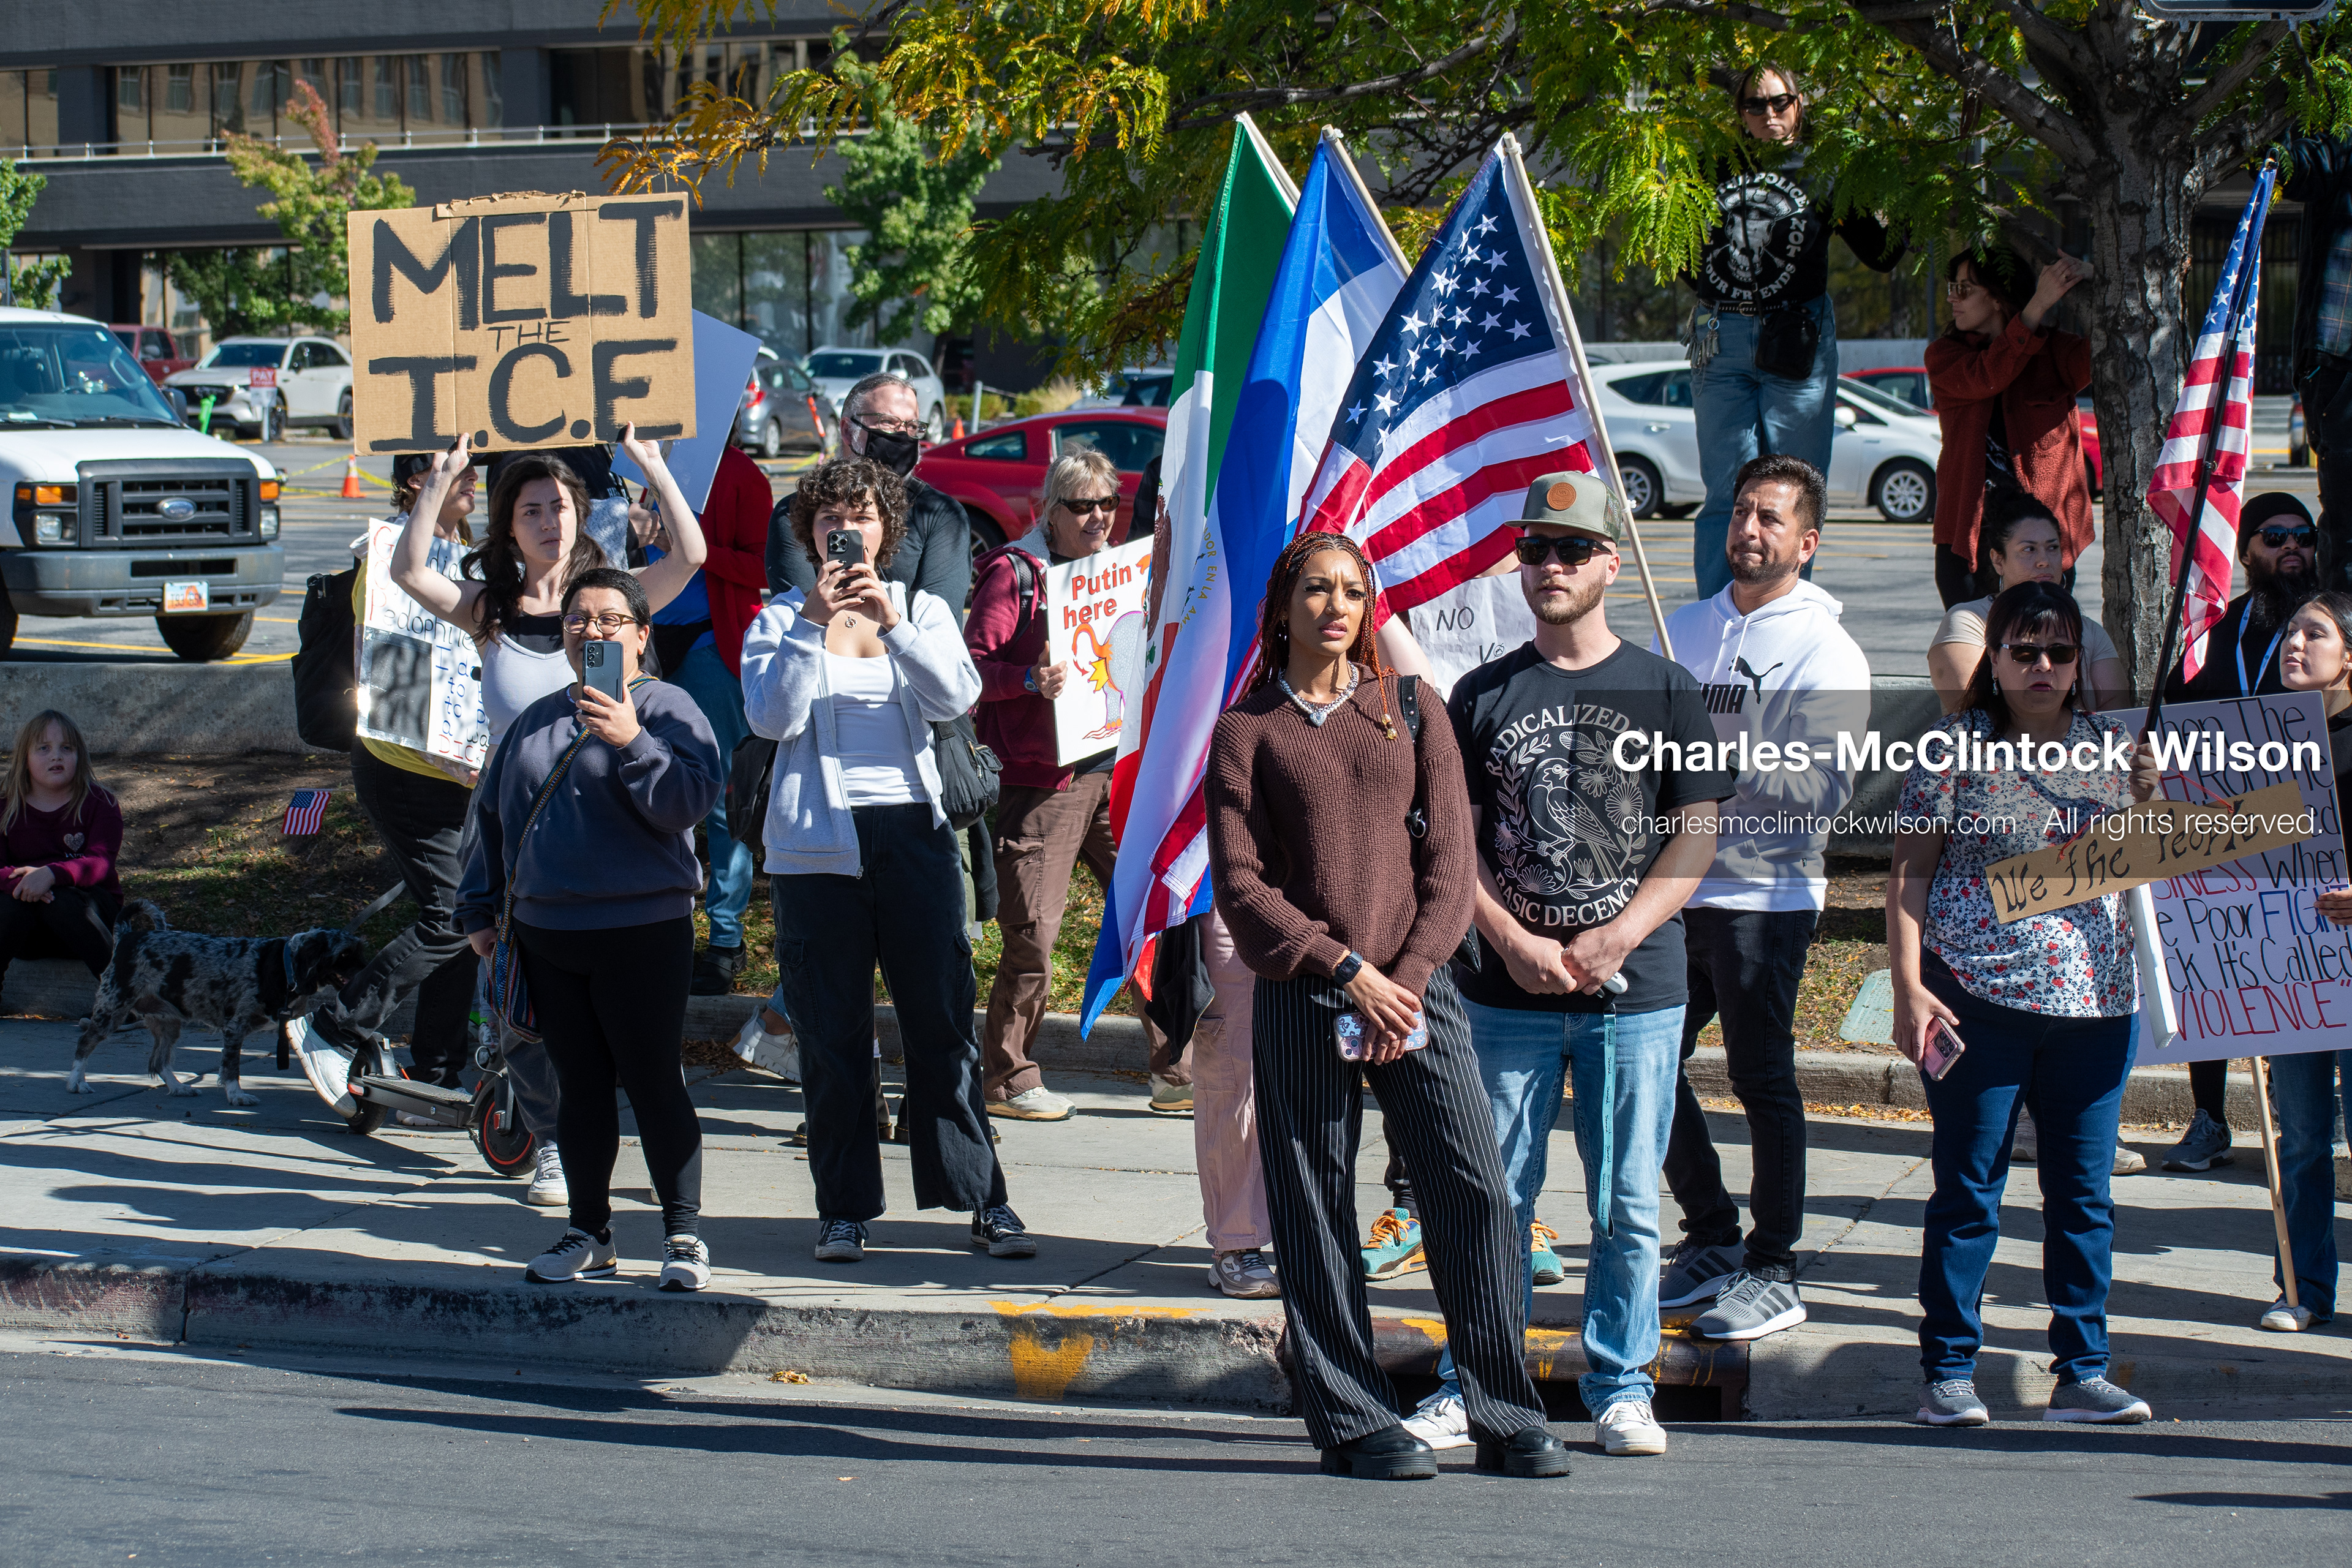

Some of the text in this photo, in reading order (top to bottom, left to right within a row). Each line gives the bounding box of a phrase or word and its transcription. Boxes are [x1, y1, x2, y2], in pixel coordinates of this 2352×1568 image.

[1753, 172, 1809, 208] POLICE
[1786, 217, 1807, 258] NOT
[372, 200, 684, 331] MELT
[1705, 252, 1796, 300] YOUR FRENDS
[486, 320, 571, 352] THE
[252, 370, 274, 381] PAY
[1071, 562, 1133, 601] Putin
[1197, 586, 1212, 599] LA
[1205, 566, 1218, 582] EN
[369, 589, 478, 654] Pedophile
[1063, 598, 1118, 630] here
[1436, 606, 1475, 631] NO
[444, 696, 462, 718] to
[448, 677, 465, 698] to
[1485, 704, 1630, 778] RADICALIZED
[1991, 863, 2048, 914] We
[2143, 799, 2259, 864] People
[2261, 842, 2350, 889] When
[1495, 868, 1640, 927] BASIC DECENCY
[2183, 898, 2253, 944] Poor
[2213, 940, 2260, 989] It's
[2260, 931, 2352, 984] Called
